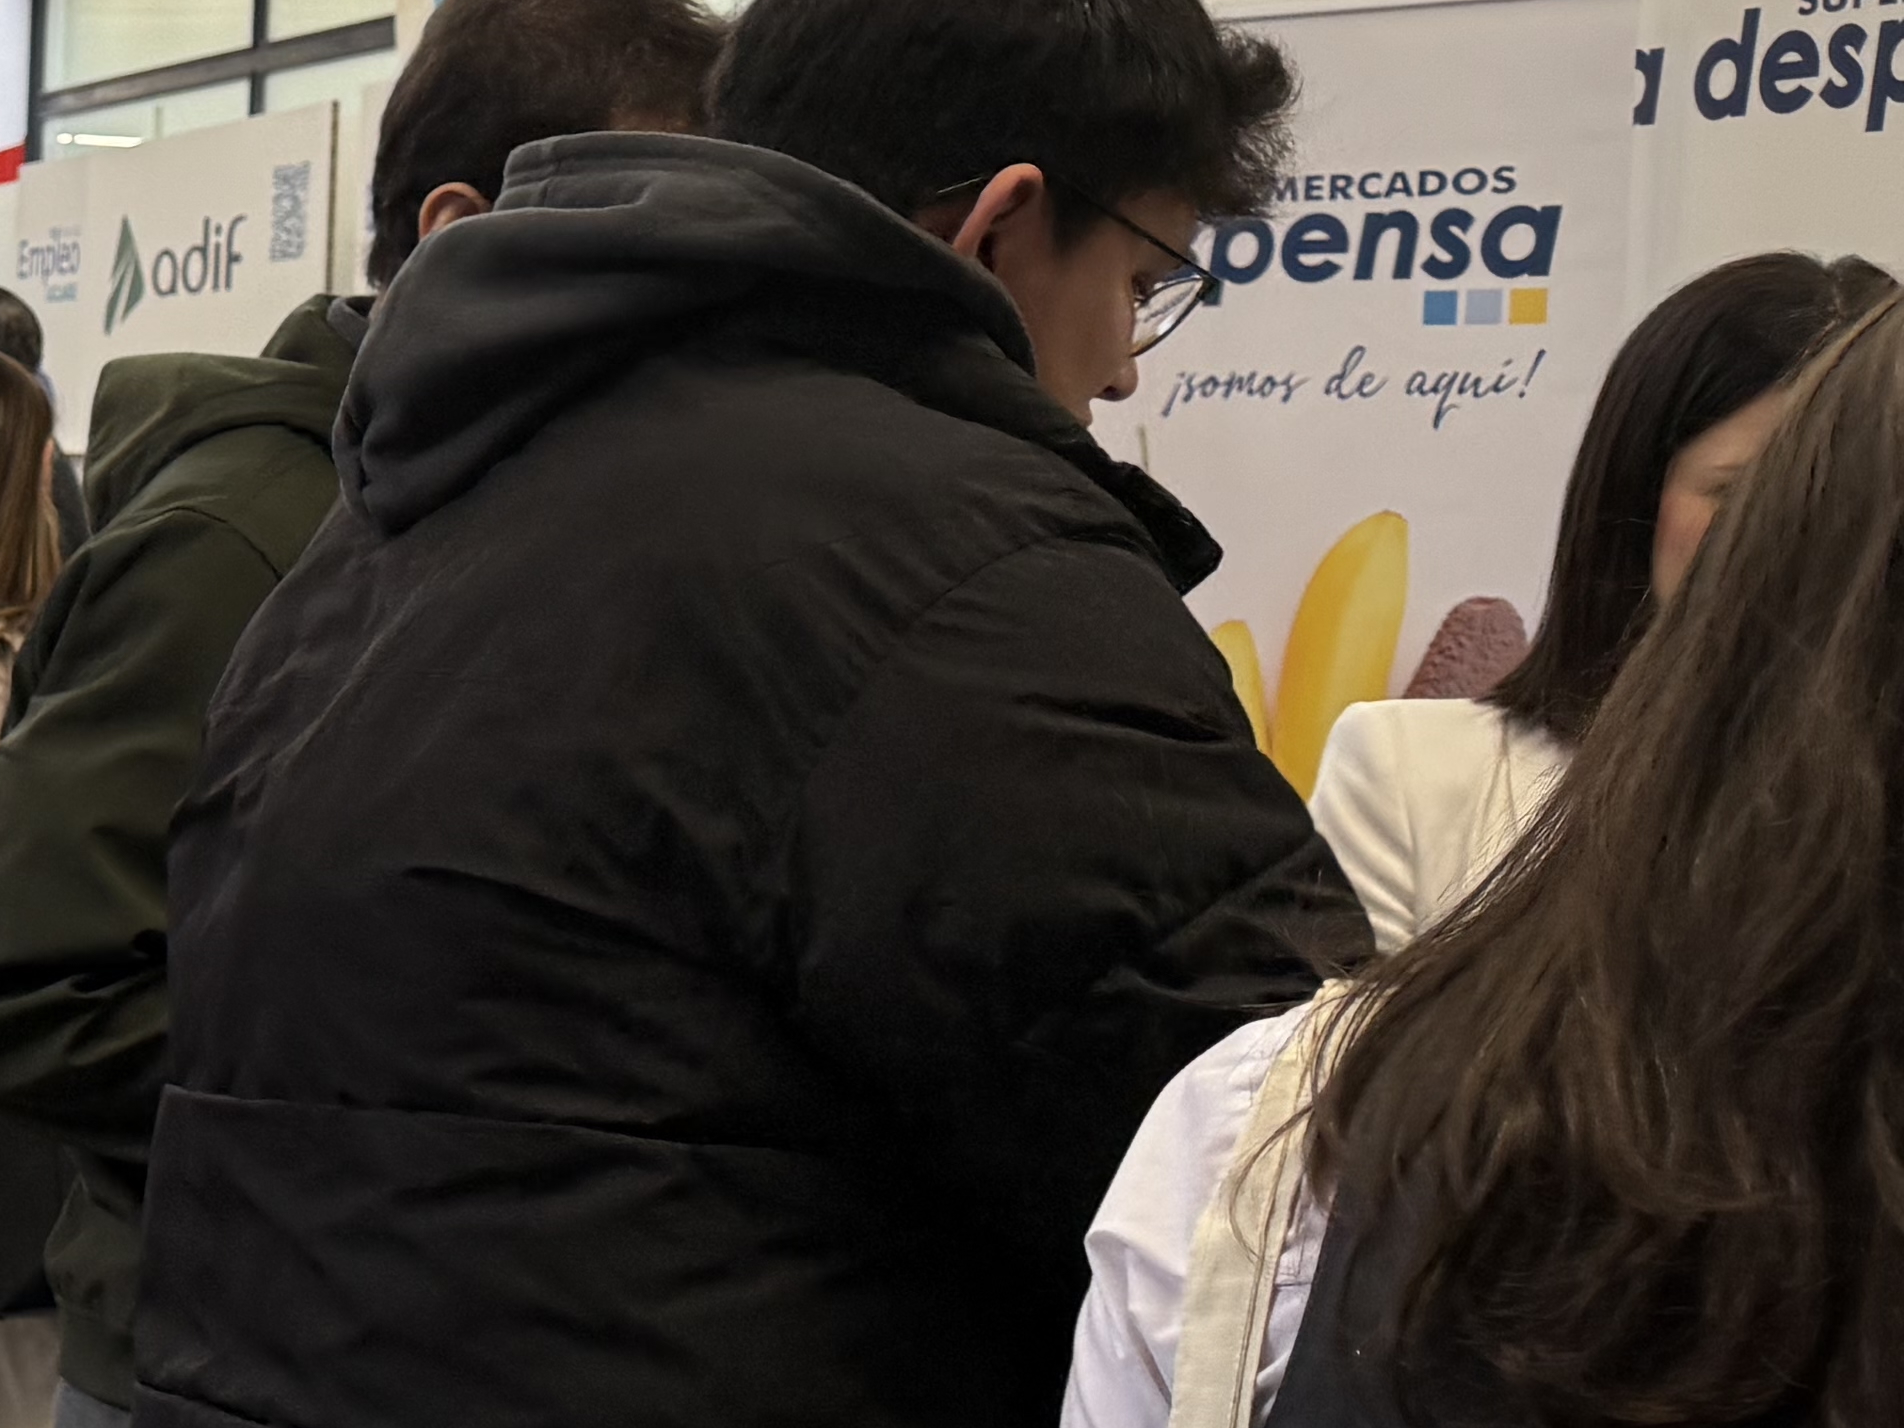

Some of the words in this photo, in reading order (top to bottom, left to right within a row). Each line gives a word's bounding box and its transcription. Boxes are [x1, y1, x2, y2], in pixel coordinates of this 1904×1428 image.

[17, 235, 81, 285] Empleo
[152, 213, 248, 297] adif
[1201, 205, 1563, 307] pensa
[1161, 368, 1310, 419] ¡somos
[1324, 345, 1390, 401] de
[1405, 348, 1547, 431] aquí!
